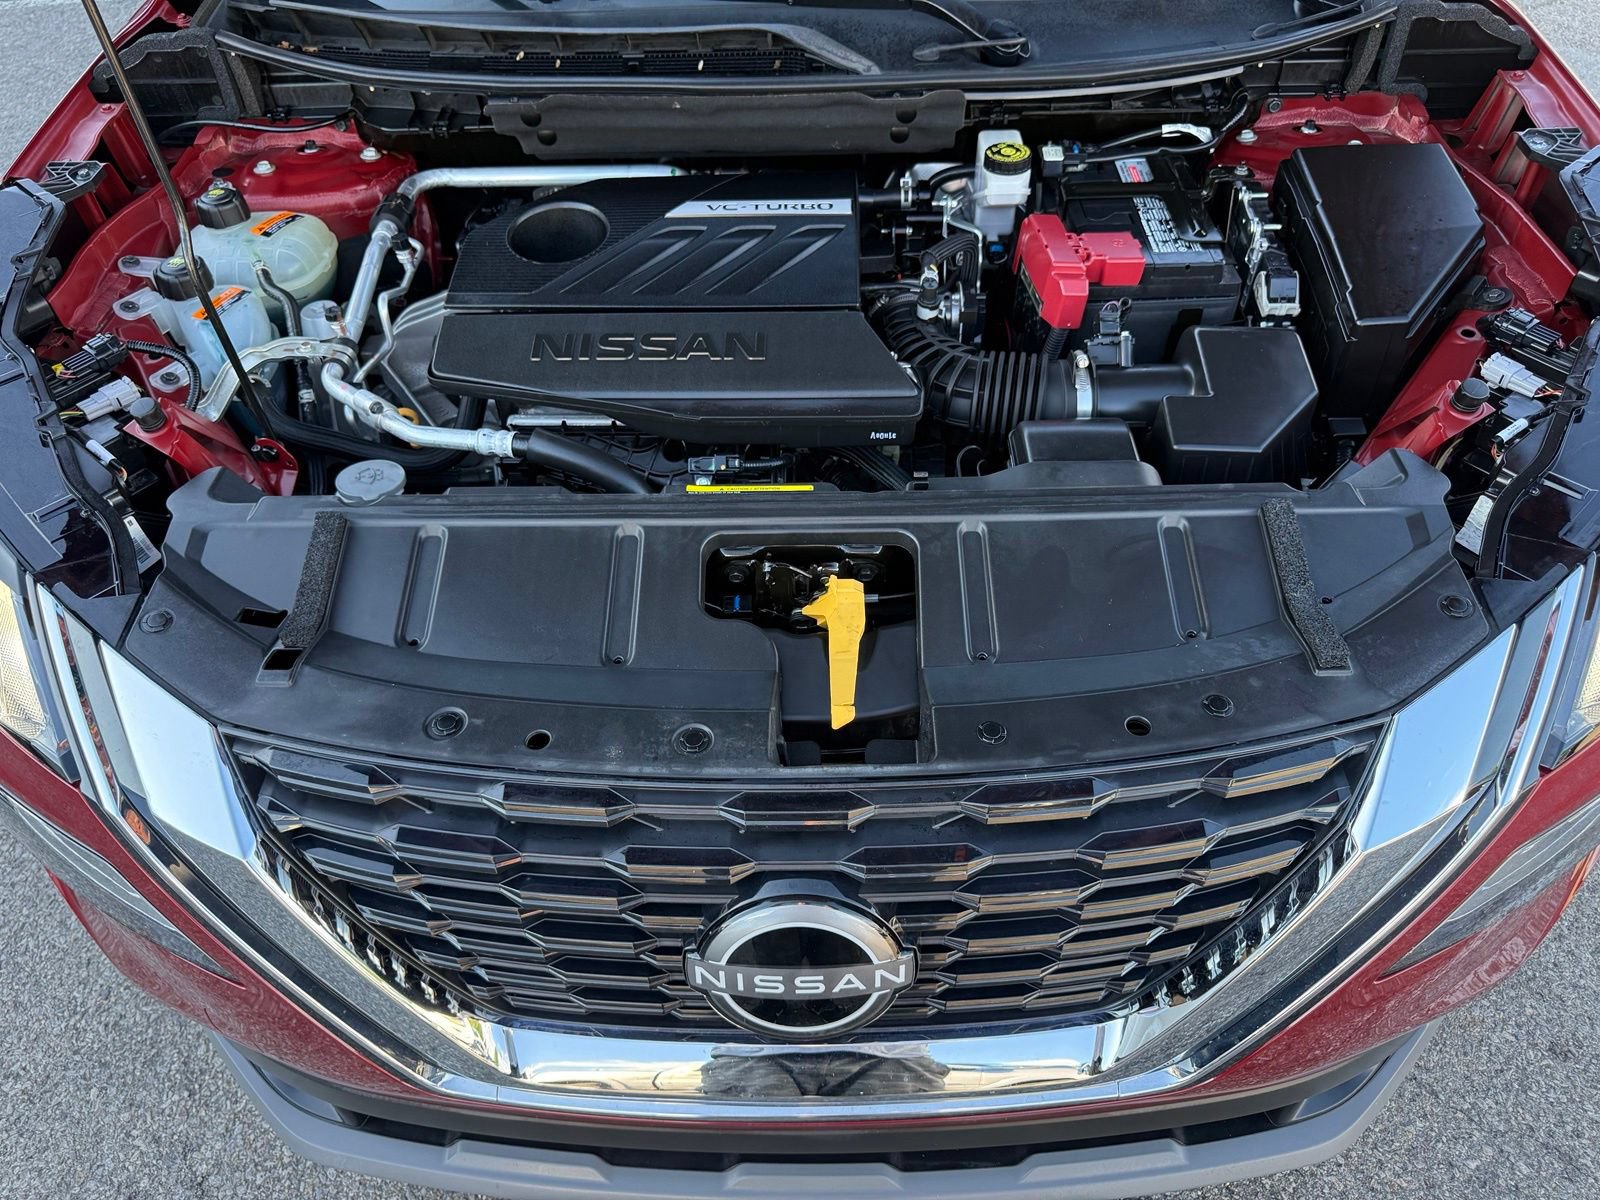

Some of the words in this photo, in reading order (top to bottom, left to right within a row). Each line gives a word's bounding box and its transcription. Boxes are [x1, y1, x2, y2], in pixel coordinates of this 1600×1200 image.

[706, 202, 834, 211] VC-TURBO
[529, 331, 768, 361] NISSAN
[693, 964, 906, 994] NISSAN
